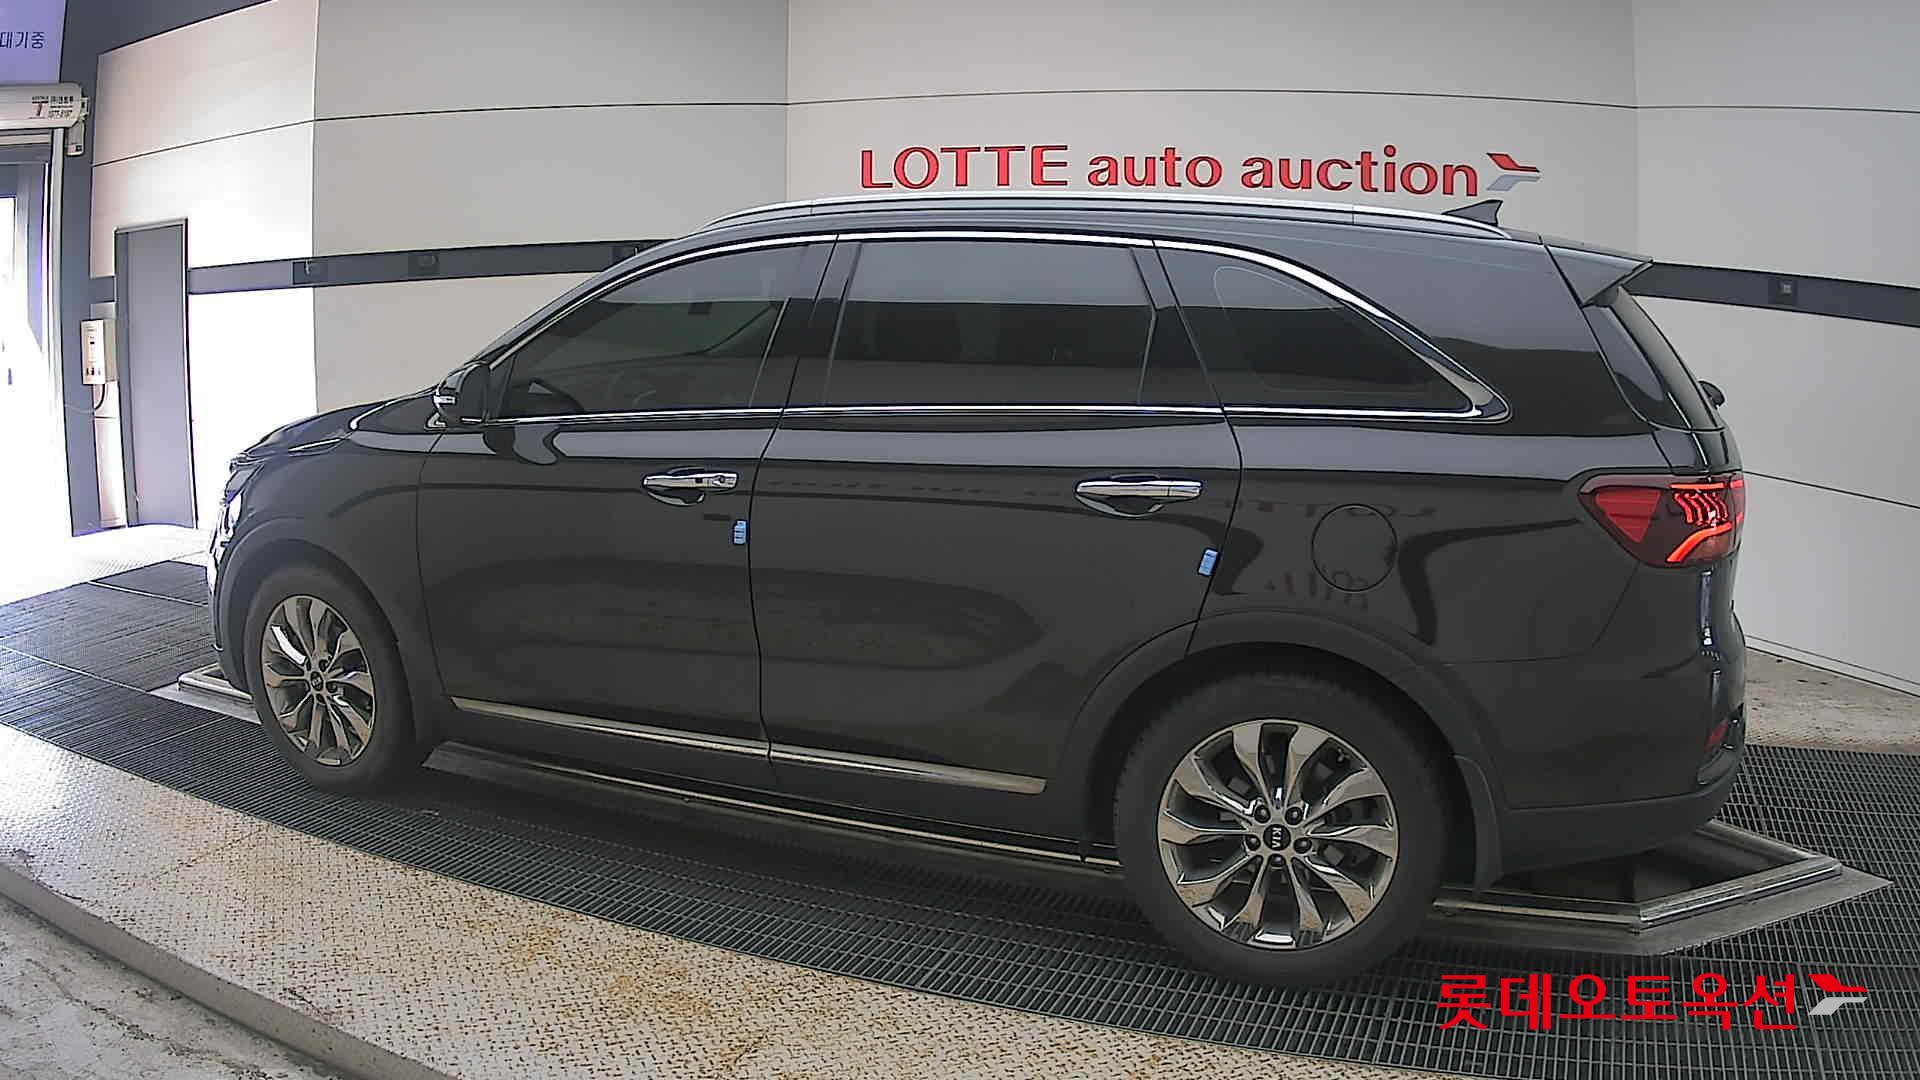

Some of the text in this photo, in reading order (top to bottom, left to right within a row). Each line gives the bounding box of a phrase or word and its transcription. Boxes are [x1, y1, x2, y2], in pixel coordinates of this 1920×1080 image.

[861, 145, 1478, 196] LOTTE auto auction
[1271, 827, 1282, 849] KIA
